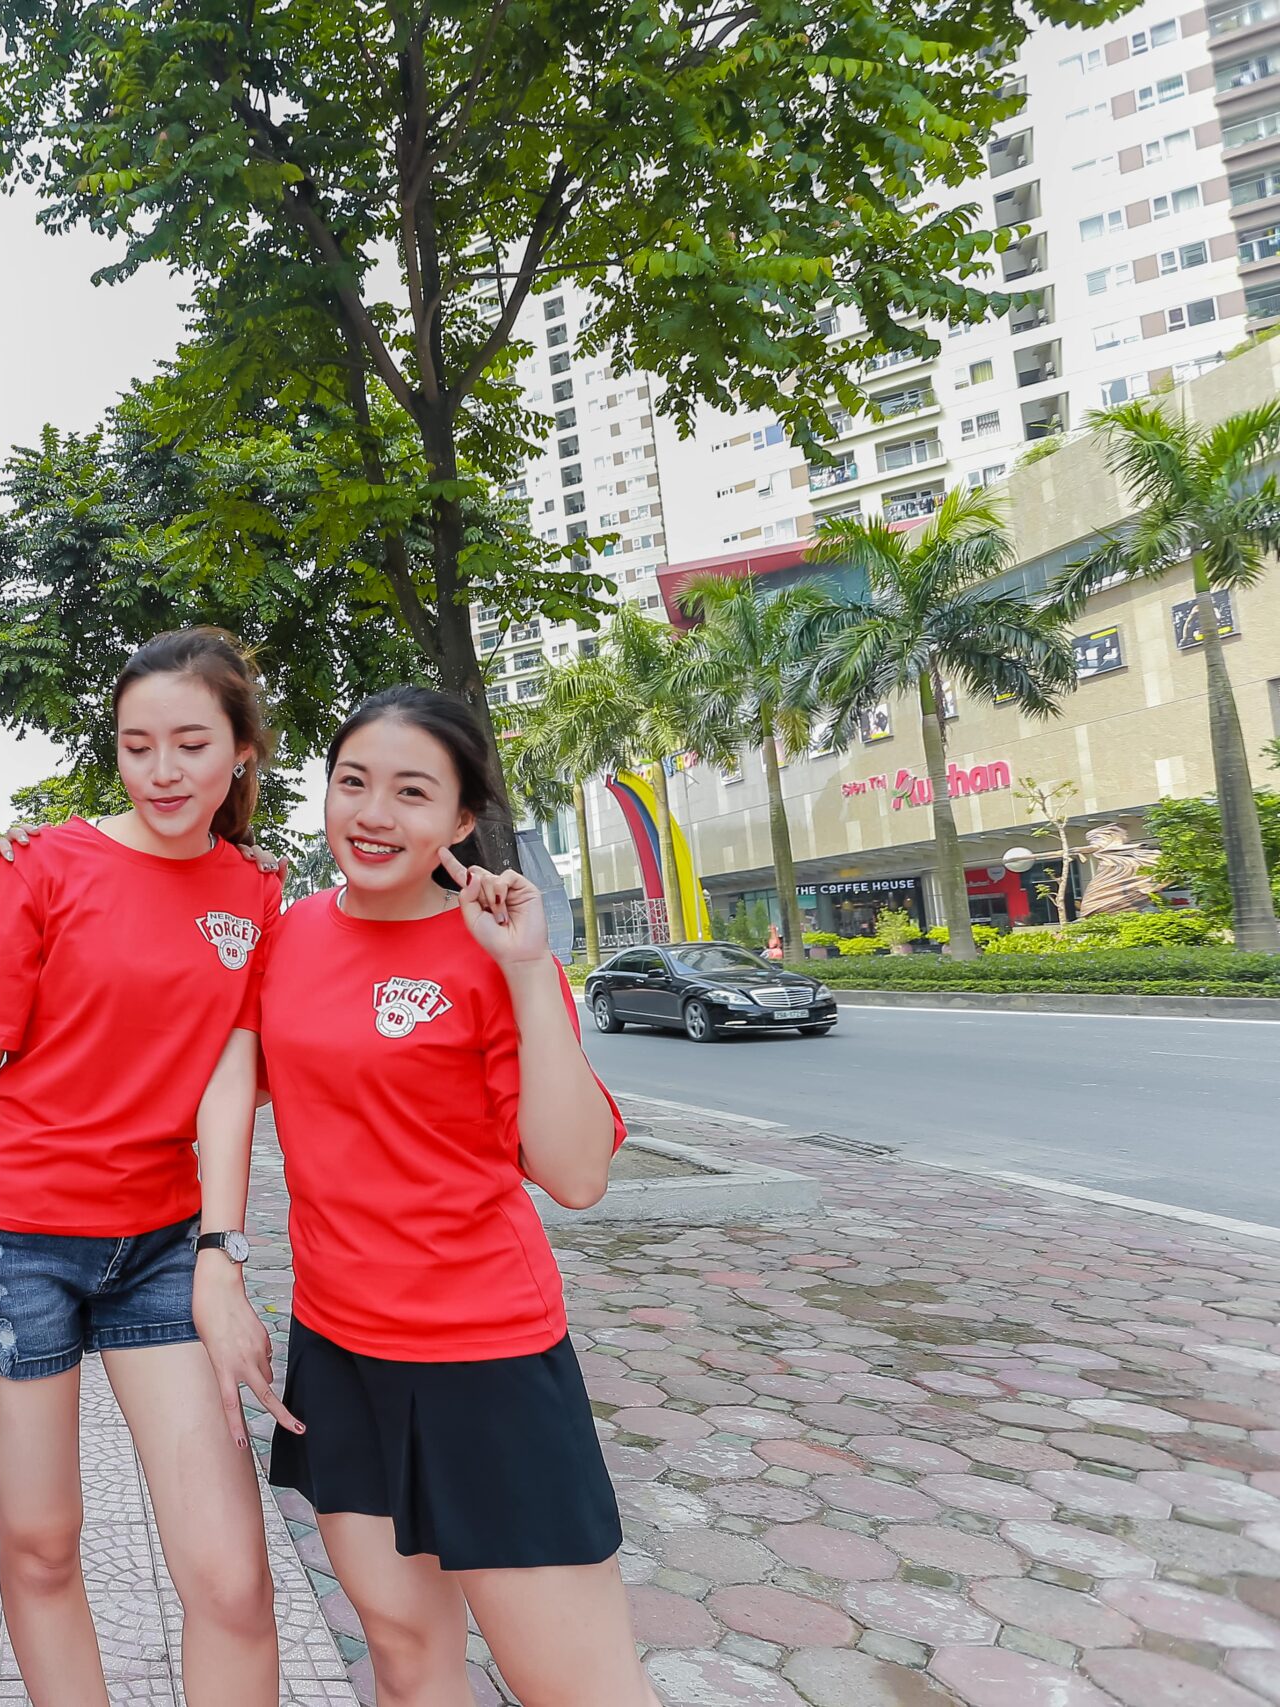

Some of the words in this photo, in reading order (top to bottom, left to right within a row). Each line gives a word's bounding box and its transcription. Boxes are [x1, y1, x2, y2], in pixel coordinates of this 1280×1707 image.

[892, 760, 1011, 811] Auhan
[795, 885, 817, 896] THE
[820, 882, 869, 895] COFFEE
[872, 879, 916, 891] HOUSE
[209, 913, 251, 927] NERVER
[200, 918, 260, 946] FORGET
[226, 947, 238, 958] 9B
[375, 984, 448, 1018] FORGET
[387, 1012, 404, 1025] 9B
